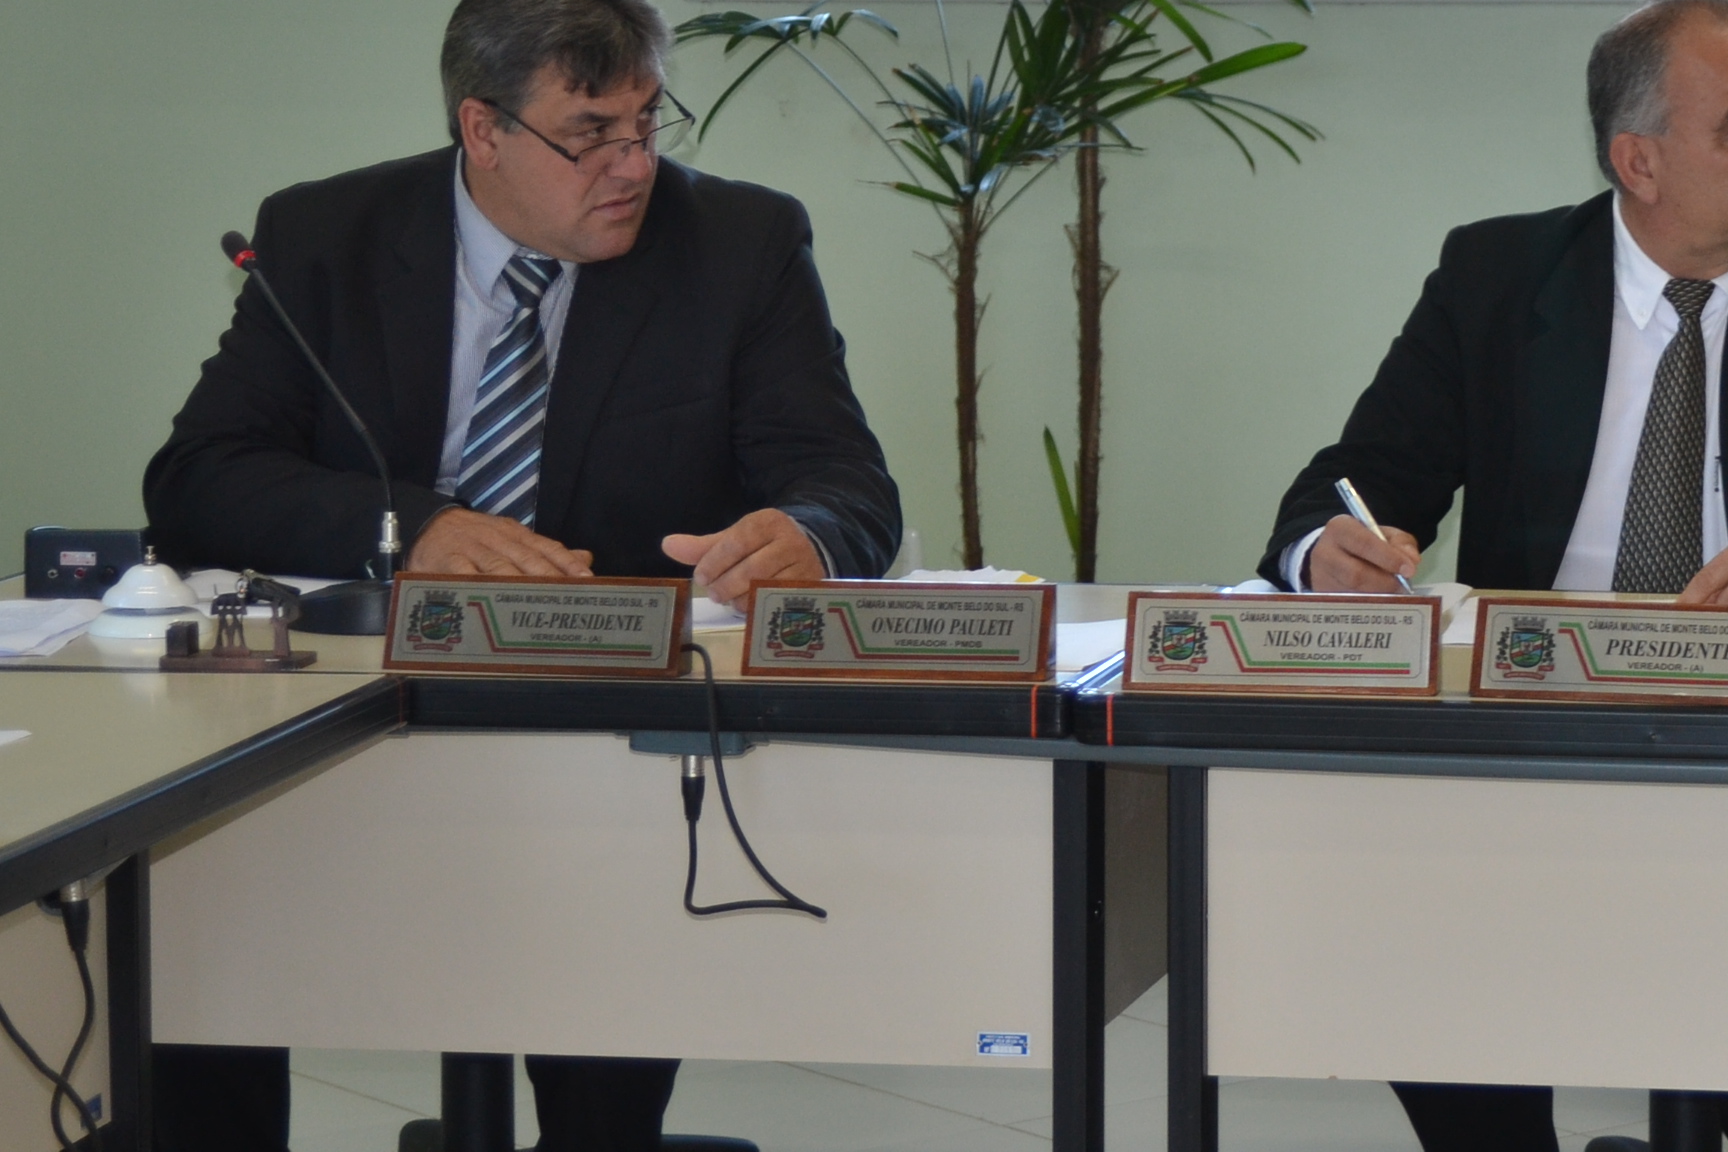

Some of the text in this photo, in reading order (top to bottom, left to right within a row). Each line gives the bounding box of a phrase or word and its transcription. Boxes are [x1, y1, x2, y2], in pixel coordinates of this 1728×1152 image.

[926, 601, 936, 611] DE
[938, 601, 962, 611] MONTE
[963, 602, 982, 612] BELO
[983, 602, 994, 612] DO
[996, 603, 1009, 612] SUL
[511, 611, 645, 632] VICE-PRESIDENTE
[1240, 612, 1270, 623] CÂMARA
[1272, 614, 1310, 623] MUNICIPAL
[1312, 614, 1322, 624] DE
[1324, 614, 1349, 624] MONTE
[1351, 615, 1370, 624] BELO
[1371, 615, 1382, 625] DO
[1384, 615, 1397, 625] SUL
[1403, 616, 1413, 625] RS
[871, 617, 1015, 637] ONECIMO PAULETI
[1588, 619, 1618, 630] CÂMARA
[1620, 621, 1658, 632] MUNICIPAL
[1660, 623, 1670, 633] DE
[1672, 623, 1697, 634] MONTE
[1699, 625, 1718, 635] BELO
[894, 639, 947, 647] VEREADOR
[1264, 630, 1393, 649] NILSO CAVALERI
[1280, 652, 1336, 661] VEREADOR
[1343, 653, 1363, 661] PDT
[1627, 662, 1682, 671] VEREADOR
